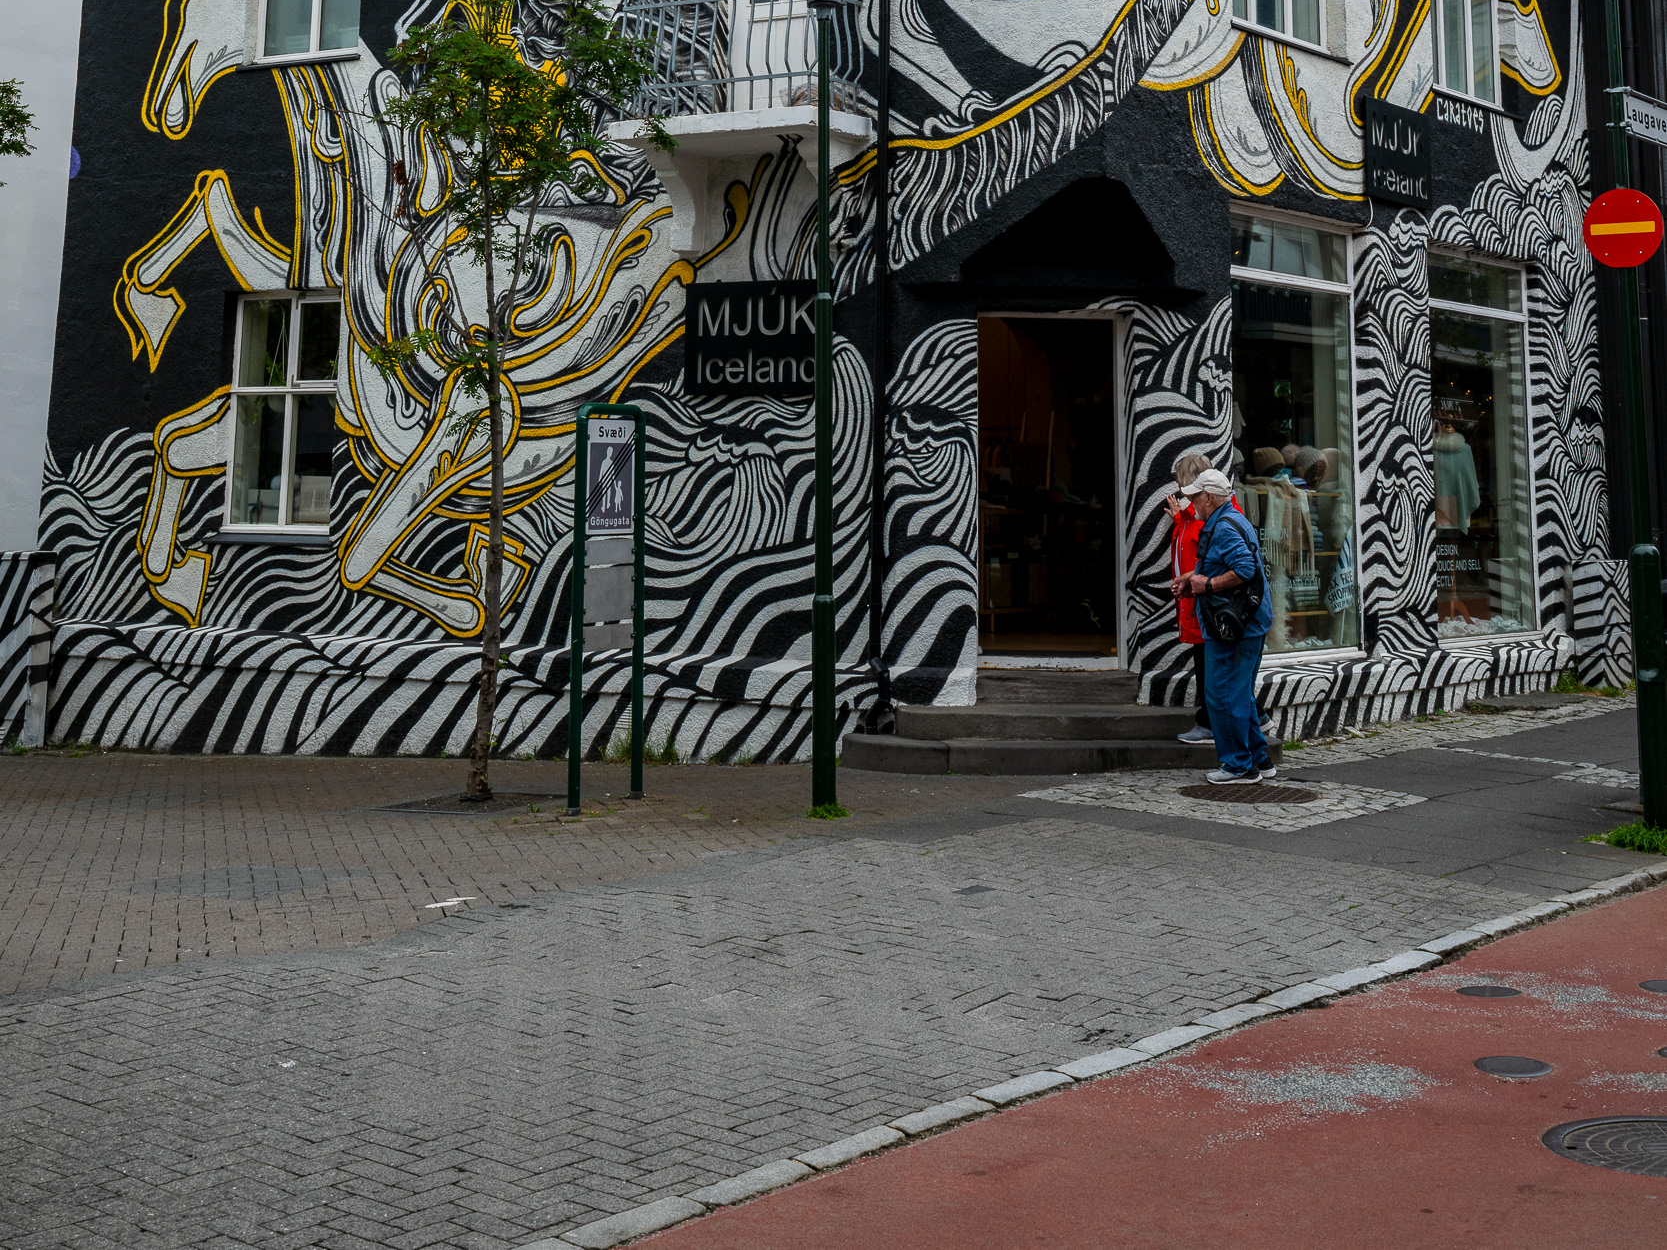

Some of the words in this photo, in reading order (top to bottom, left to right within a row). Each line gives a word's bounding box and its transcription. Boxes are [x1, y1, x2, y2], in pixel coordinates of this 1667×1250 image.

[697, 286, 816, 337] MJÚK
[598, 426, 626, 439] Svæði
[590, 516, 630, 528] Göngugata
[1455, 559, 1468, 571] AND
[1467, 559, 1482, 571] SELL
